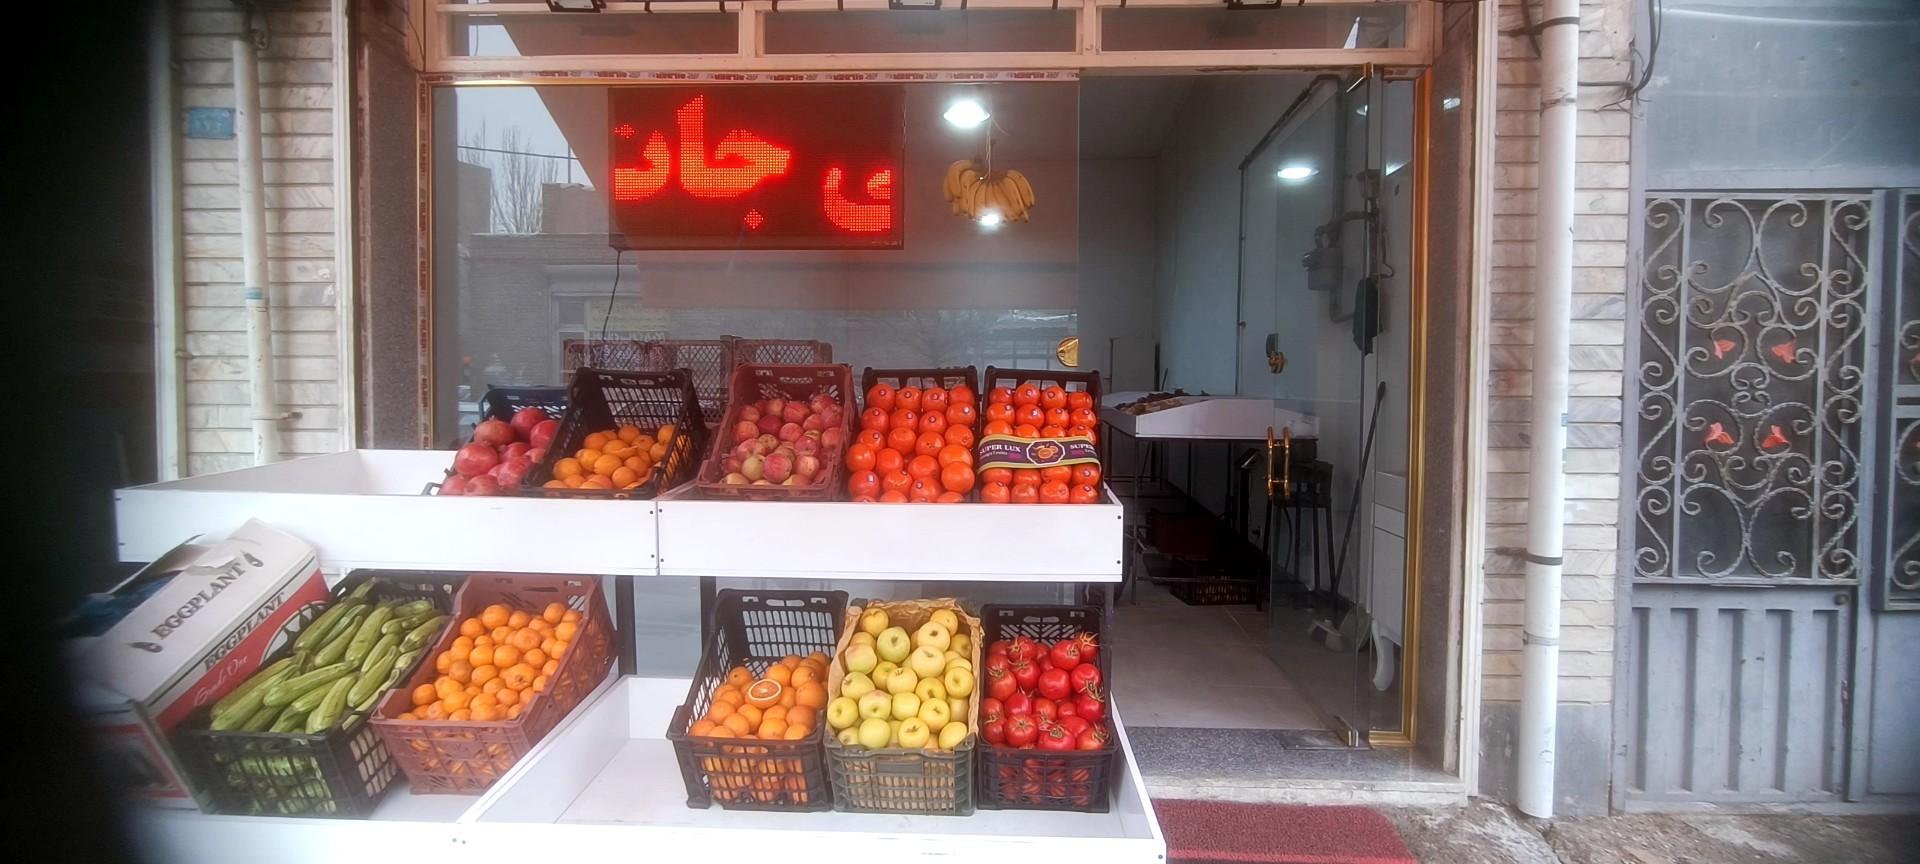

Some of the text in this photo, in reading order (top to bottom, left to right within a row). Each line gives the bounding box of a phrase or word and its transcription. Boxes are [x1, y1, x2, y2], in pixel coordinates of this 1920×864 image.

[1004, 444, 1021, 453] LUX
[151, 561, 246, 641] EGGPLANT
[202, 591, 287, 673] EGGPLANT
